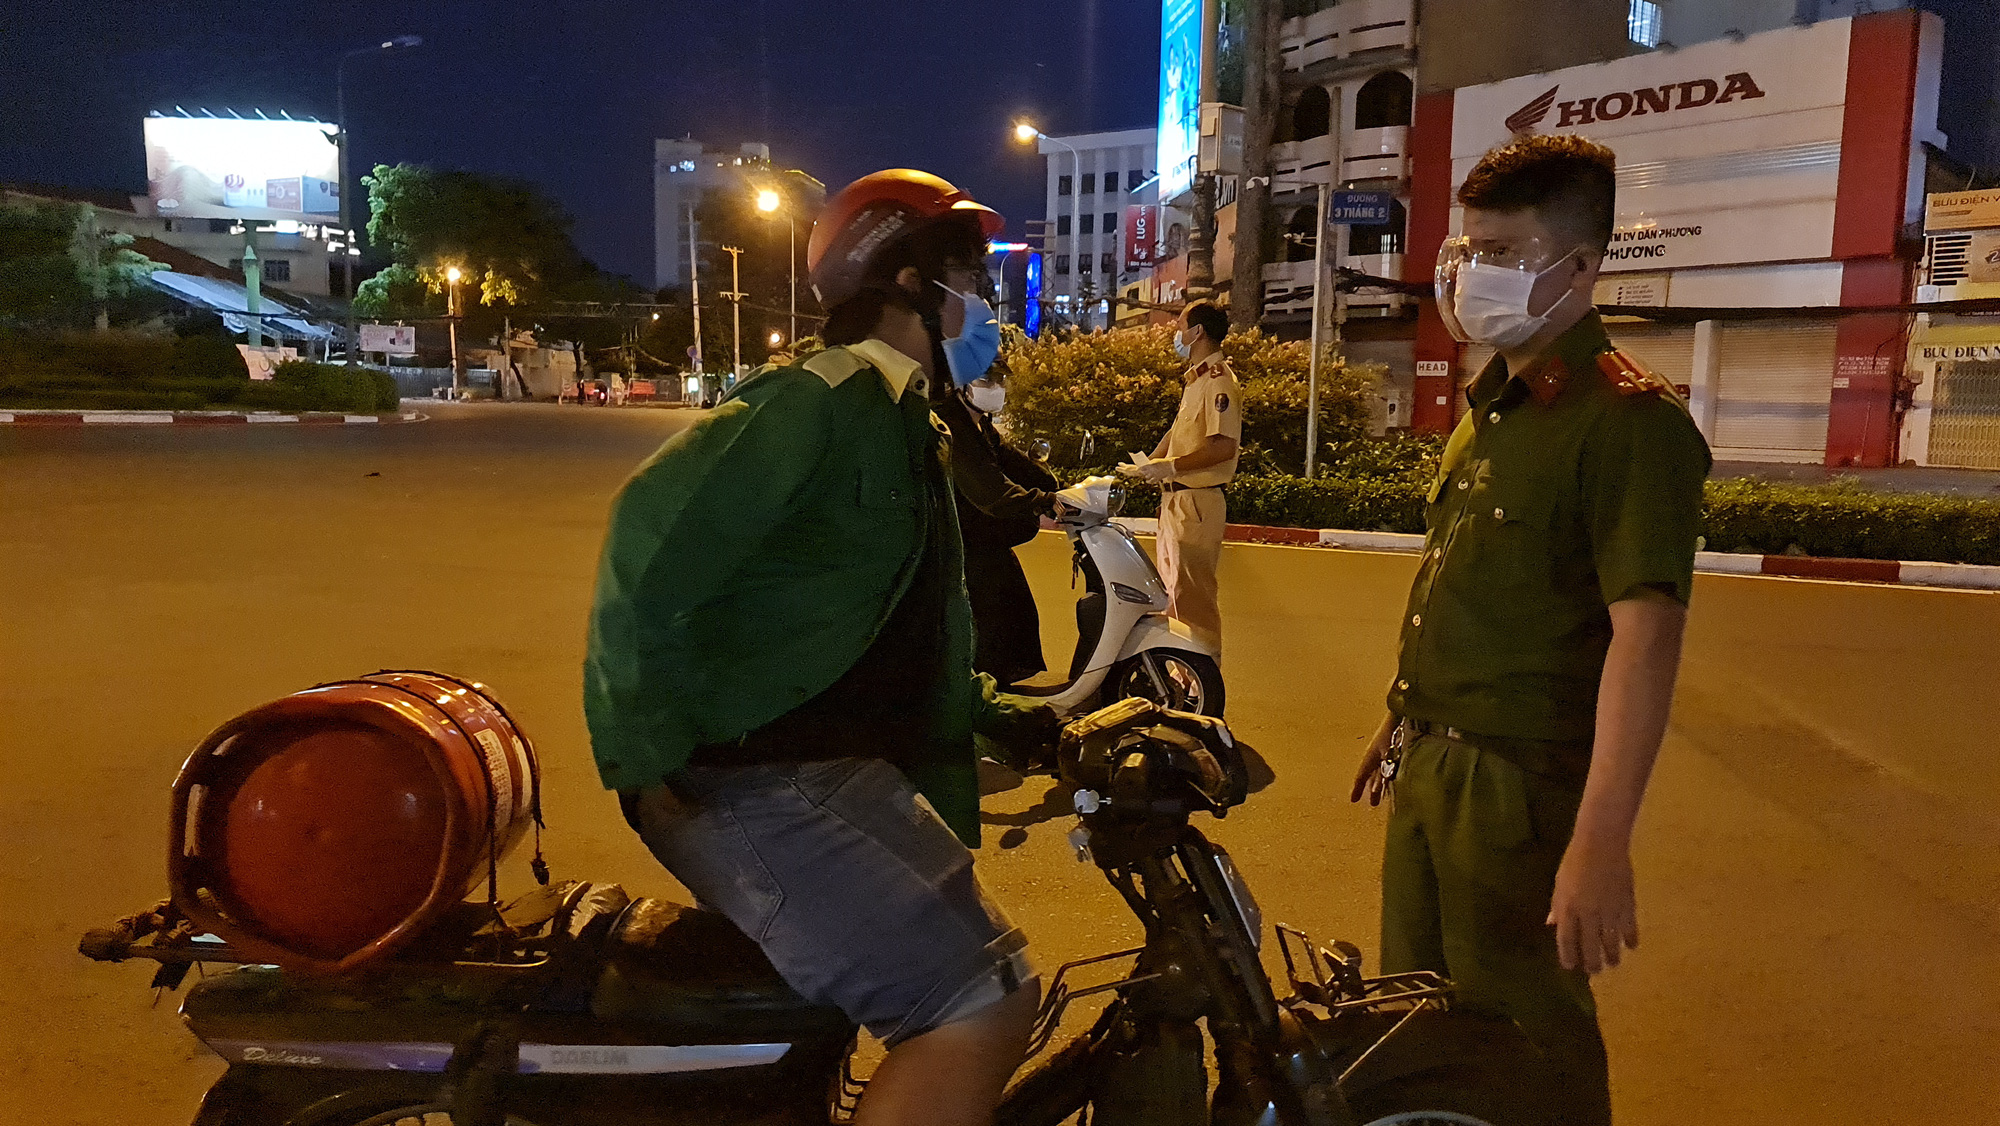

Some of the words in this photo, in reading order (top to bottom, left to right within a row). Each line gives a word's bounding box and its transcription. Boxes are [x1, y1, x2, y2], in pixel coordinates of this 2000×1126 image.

[1555, 72, 1766, 128] HONDA
[1334, 207, 1342, 218] 3
[1343, 203, 1375, 218] THÁNG
[1378, 206, 1386, 218] 2
[1623, 231, 1636, 242] DV
[1659, 225, 1703, 239] PHƯƠNG
[1602, 244, 1667, 260] PHƯƠNG
[1418, 363, 1447, 371] HEAD
